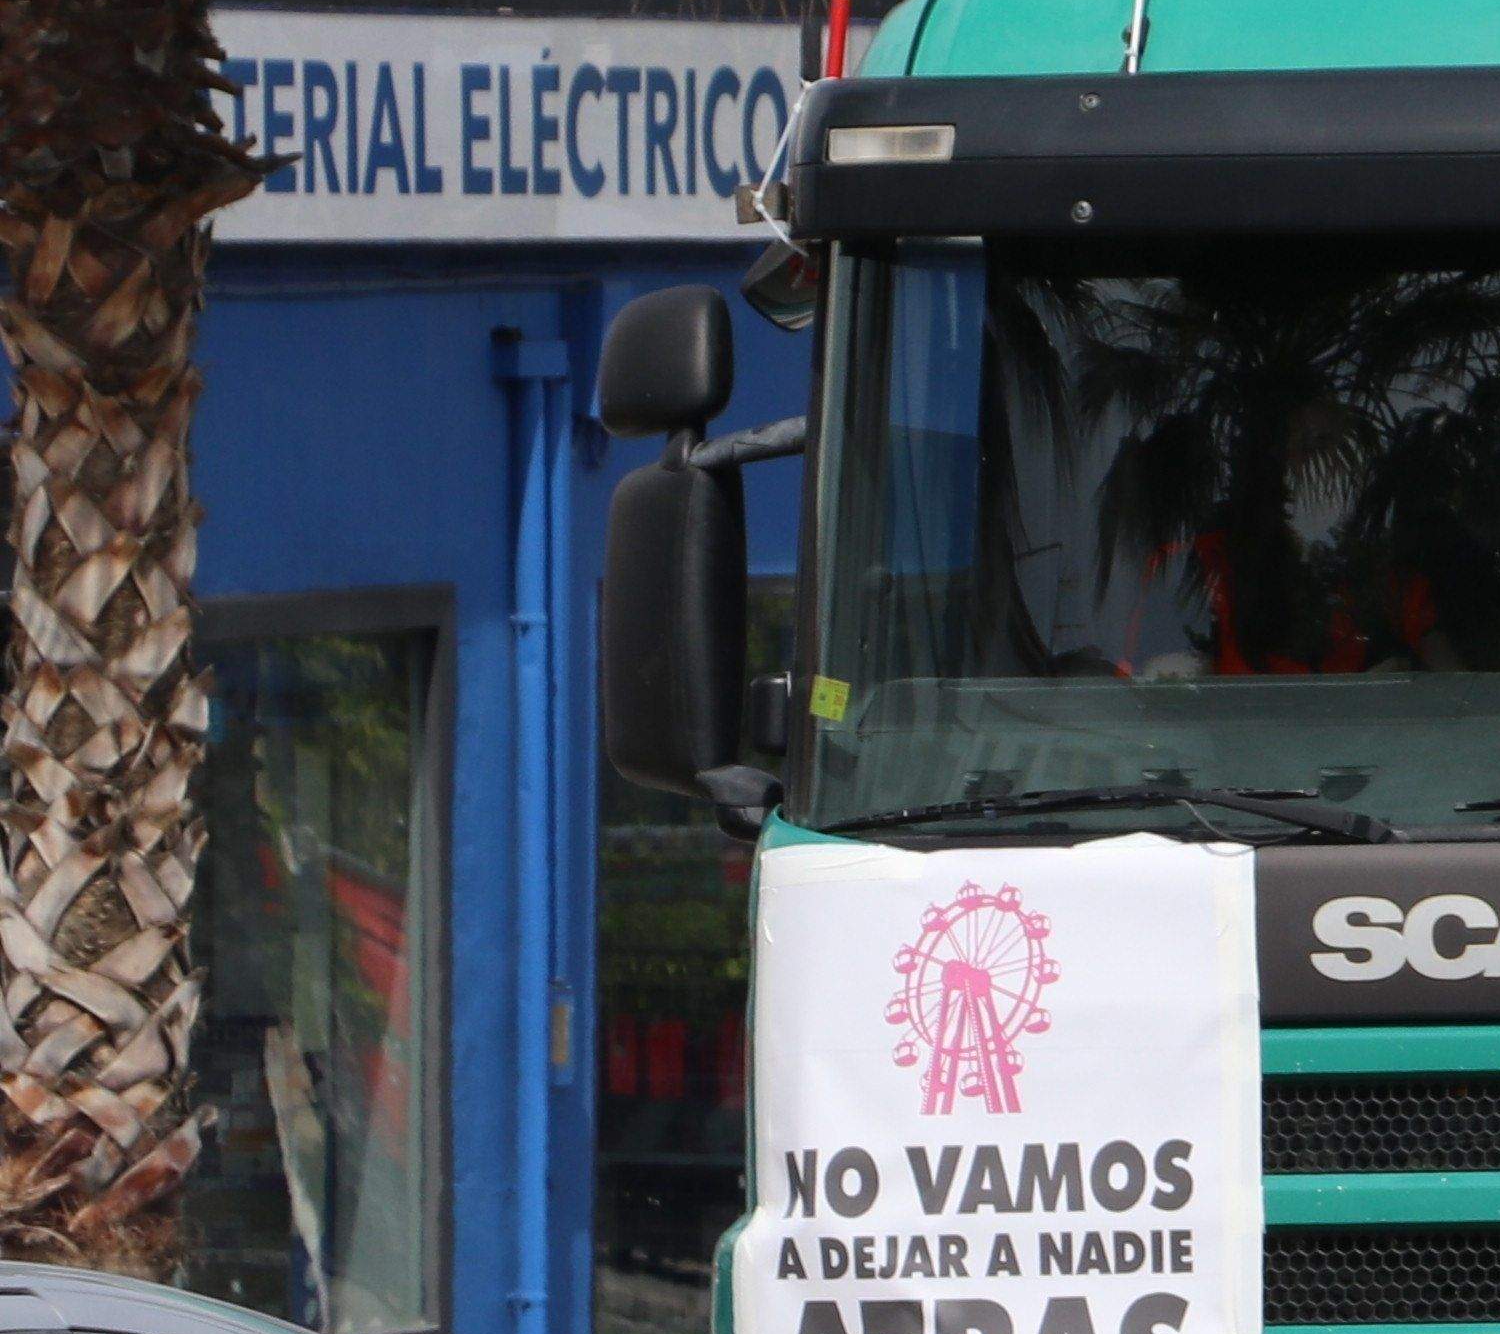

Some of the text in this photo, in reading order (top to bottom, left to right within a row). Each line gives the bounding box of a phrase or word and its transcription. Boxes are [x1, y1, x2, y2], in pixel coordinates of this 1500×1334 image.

[212, 48, 788, 198] TERIAL ELÉCTRICO
[785, 1139, 1194, 1219] NO VAMOS
[776, 1229, 1194, 1280] A DEJAR A NADIE
